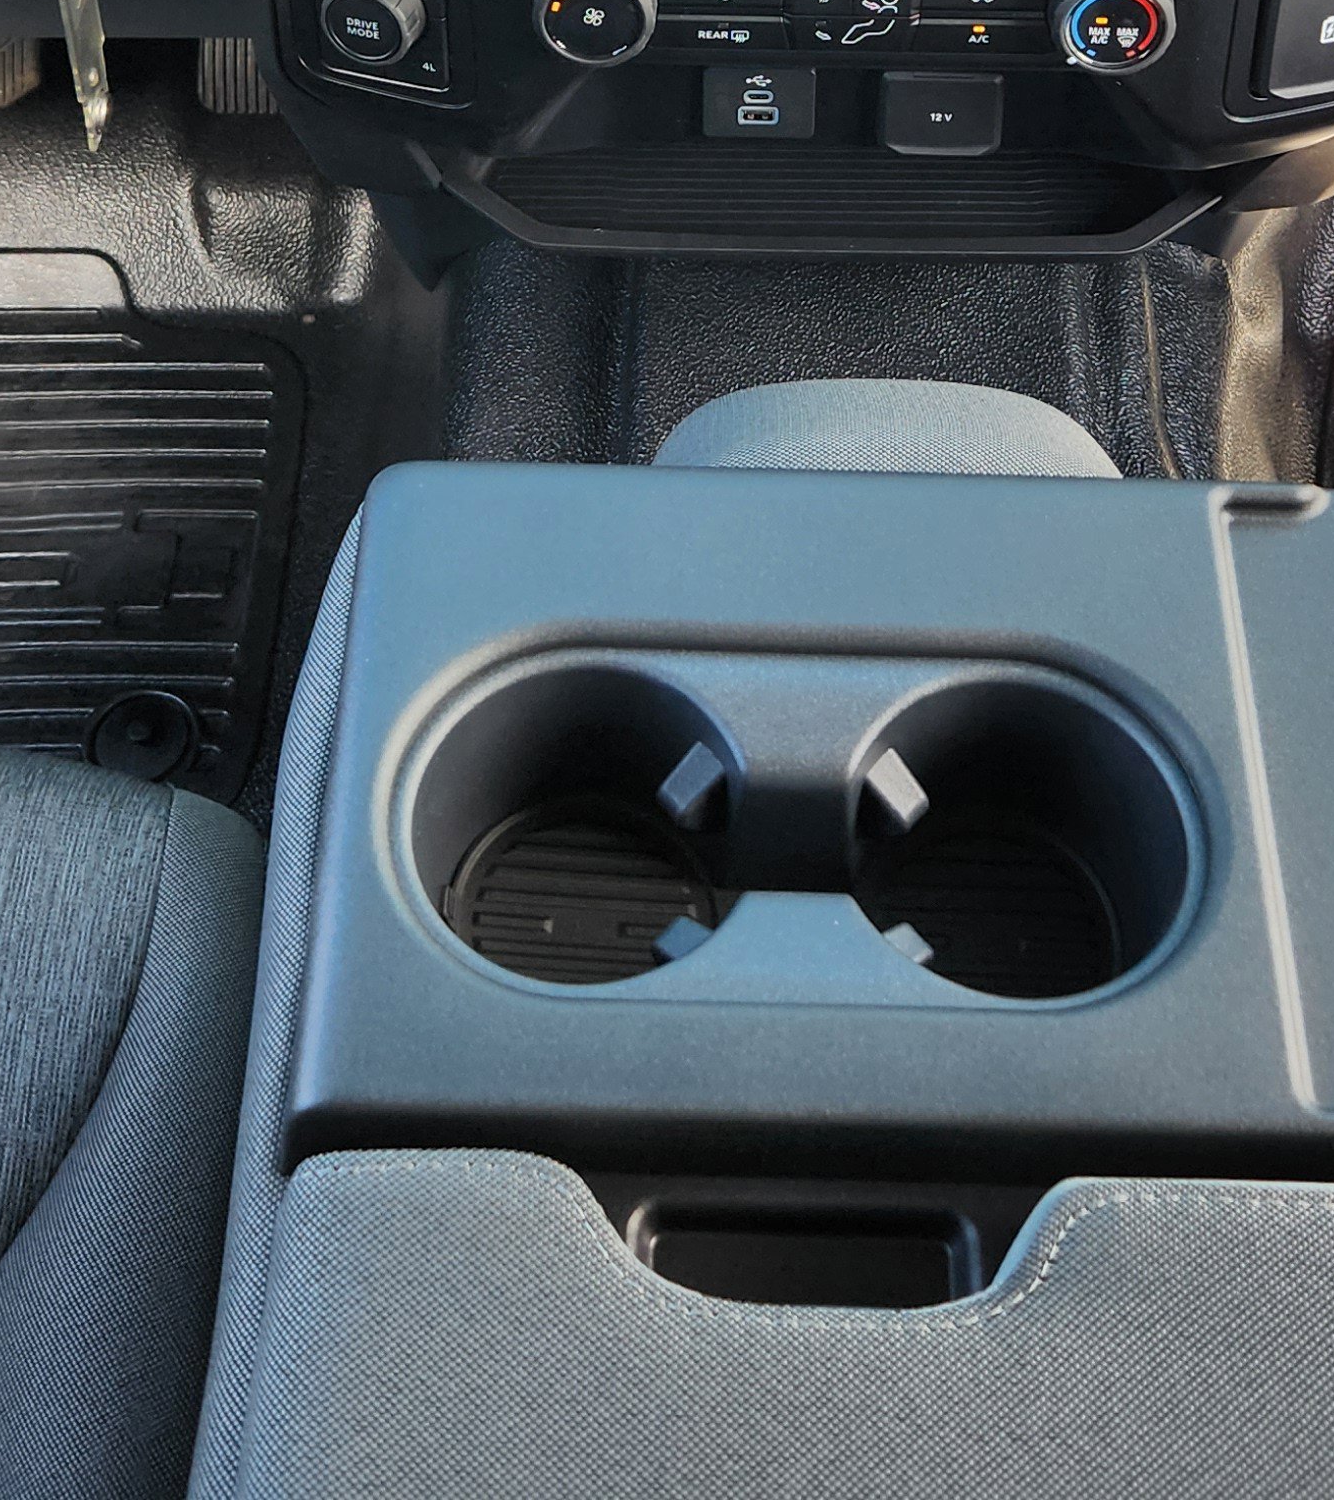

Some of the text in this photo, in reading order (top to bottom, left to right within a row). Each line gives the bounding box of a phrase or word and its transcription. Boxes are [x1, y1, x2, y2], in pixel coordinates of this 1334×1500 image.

[345, 17, 380, 32] DRIVE
[346, 26, 381, 41] MODE
[697, 30, 729, 40] REAR
[1088, 26, 1111, 36] MAX
[1116, 27, 1140, 37] MAX
[968, 34, 990, 45] A/C
[1090, 35, 1109, 45] A/C
[421, 62, 437, 73] 4L
[929, 112, 953, 122] 12 V
